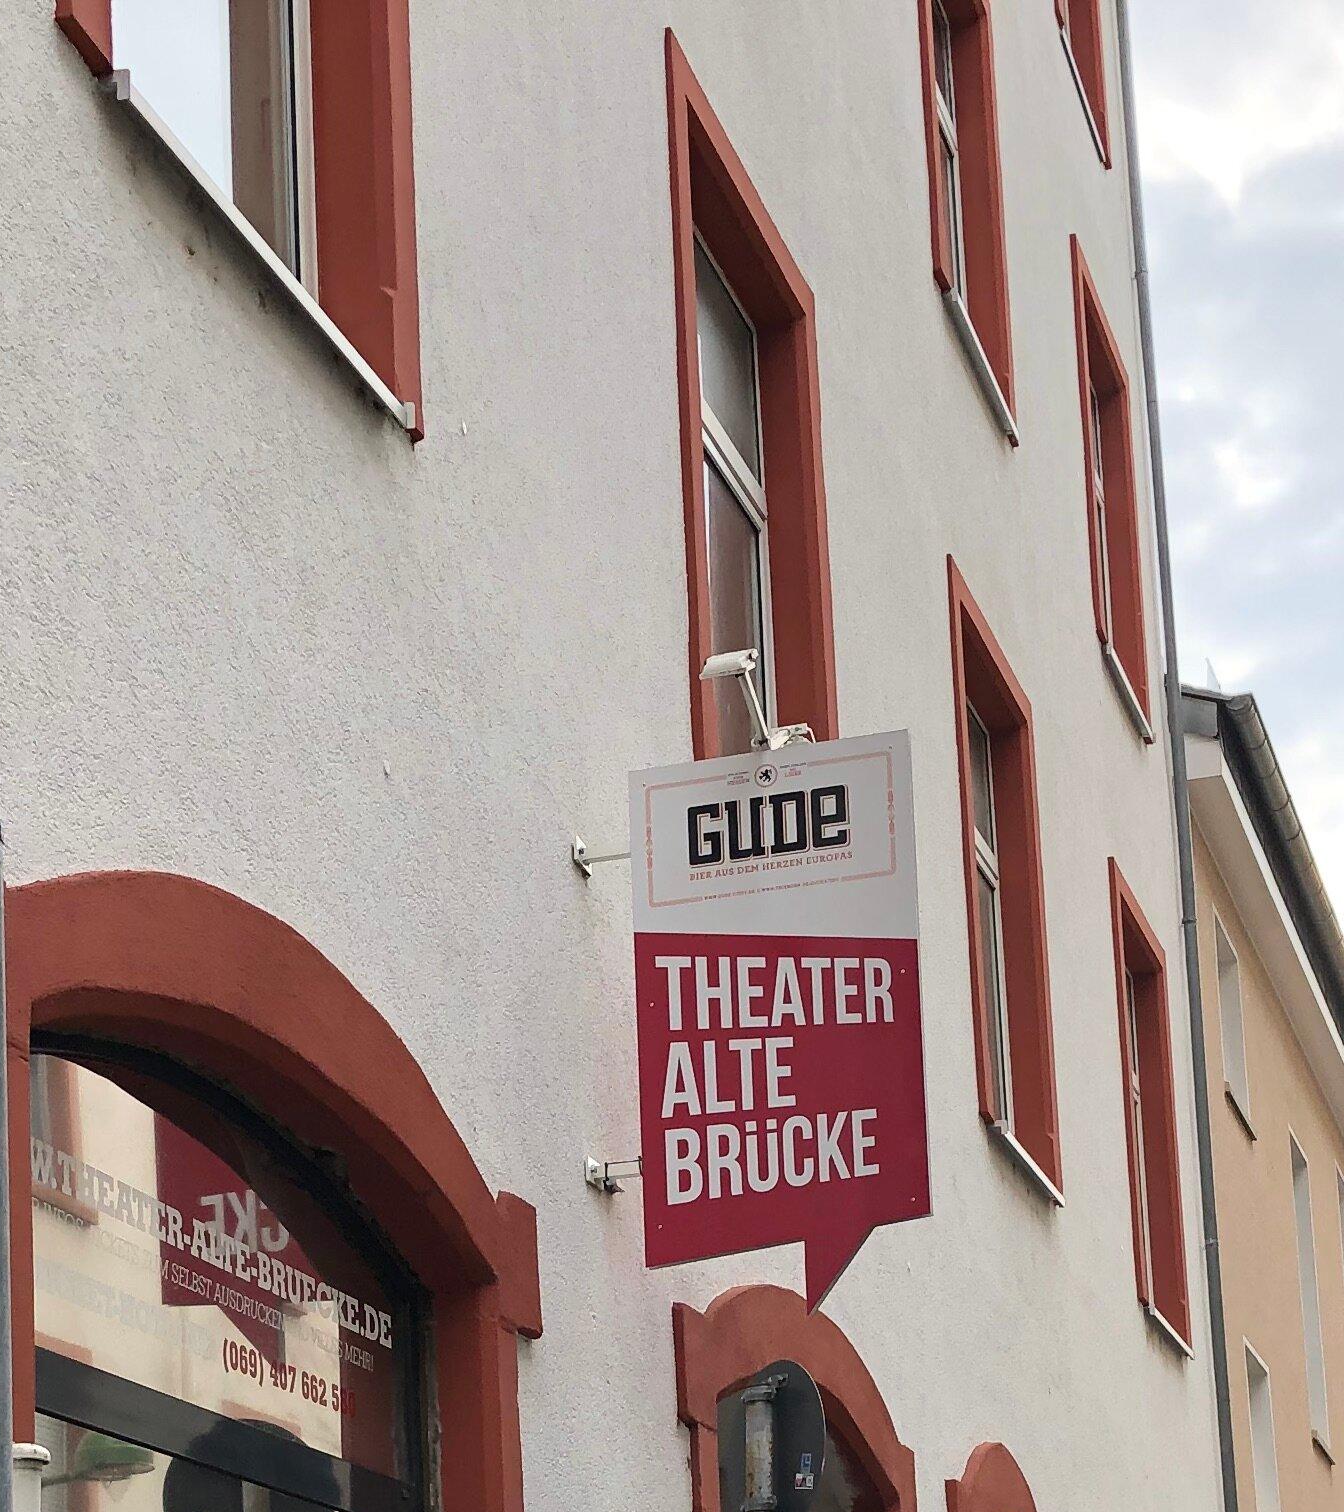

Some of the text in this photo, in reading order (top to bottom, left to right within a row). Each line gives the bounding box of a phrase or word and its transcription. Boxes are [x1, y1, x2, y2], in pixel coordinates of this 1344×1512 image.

[689, 851, 853, 881] BIER AUS DEM HERZEN EUROPAS
[655, 956, 894, 1031] THEATER
[661, 1037, 796, 1119] ALTE
[171, 1263, 213, 1299] SELBST
[223, 1337, 263, 1387] (069)
[269, 1360, 296, 1393] 407
[301, 1371, 327, 1407] 662
